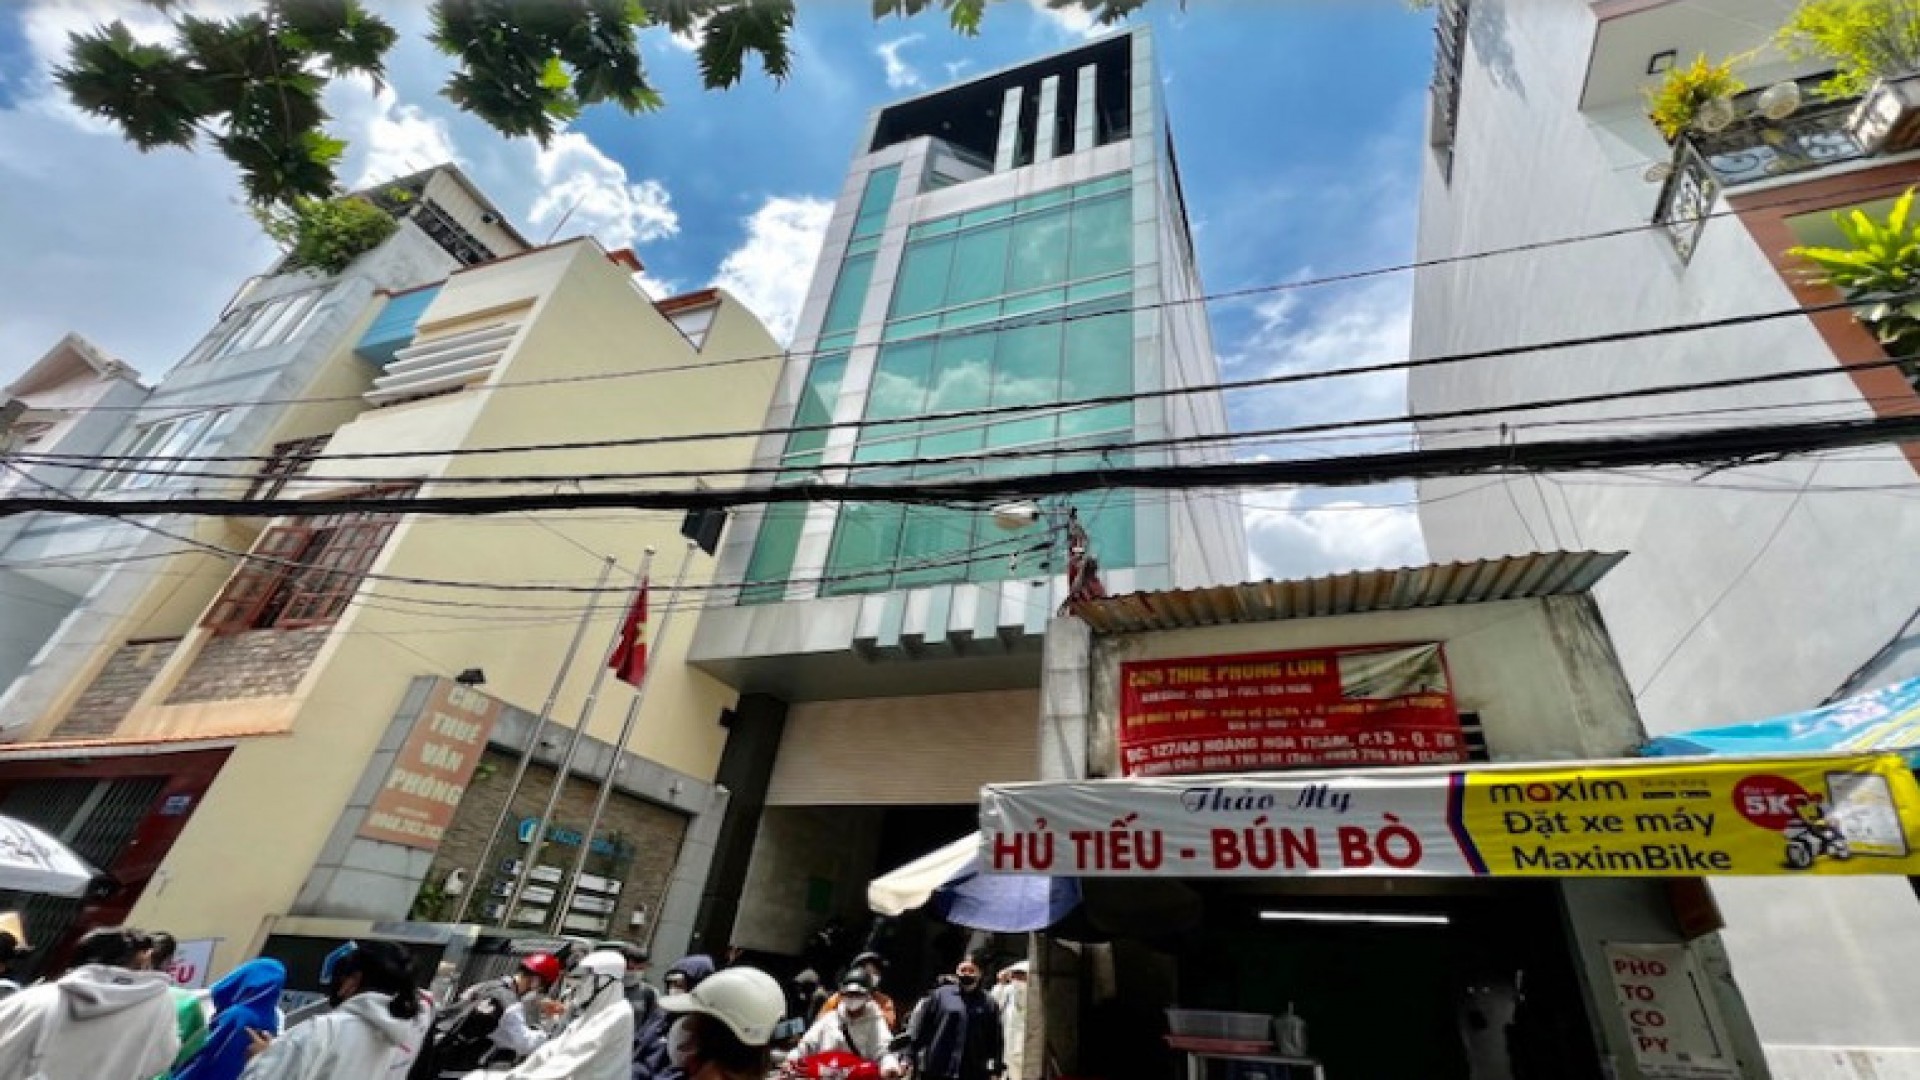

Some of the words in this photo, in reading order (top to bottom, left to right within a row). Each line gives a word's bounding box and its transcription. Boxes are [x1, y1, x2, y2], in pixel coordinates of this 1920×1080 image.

[1489, 777, 1627, 803] maxim
[1503, 809, 1570, 839] Đặt
[1580, 814, 1623, 833] xe
[1635, 806, 1714, 837] máy
[994, 817, 1053, 870] HỦ
[1069, 811, 1163, 870] TIẾU
[1210, 815, 1319, 869] BÚN
[1338, 812, 1422, 869] BÒ
[1512, 844, 1732, 870] MaximBike
[1613, 959, 1667, 976] PHO
[1620, 985, 1654, 1001] TO
[1630, 1009, 1666, 1027] CO
[1638, 1036, 1668, 1053] PY
